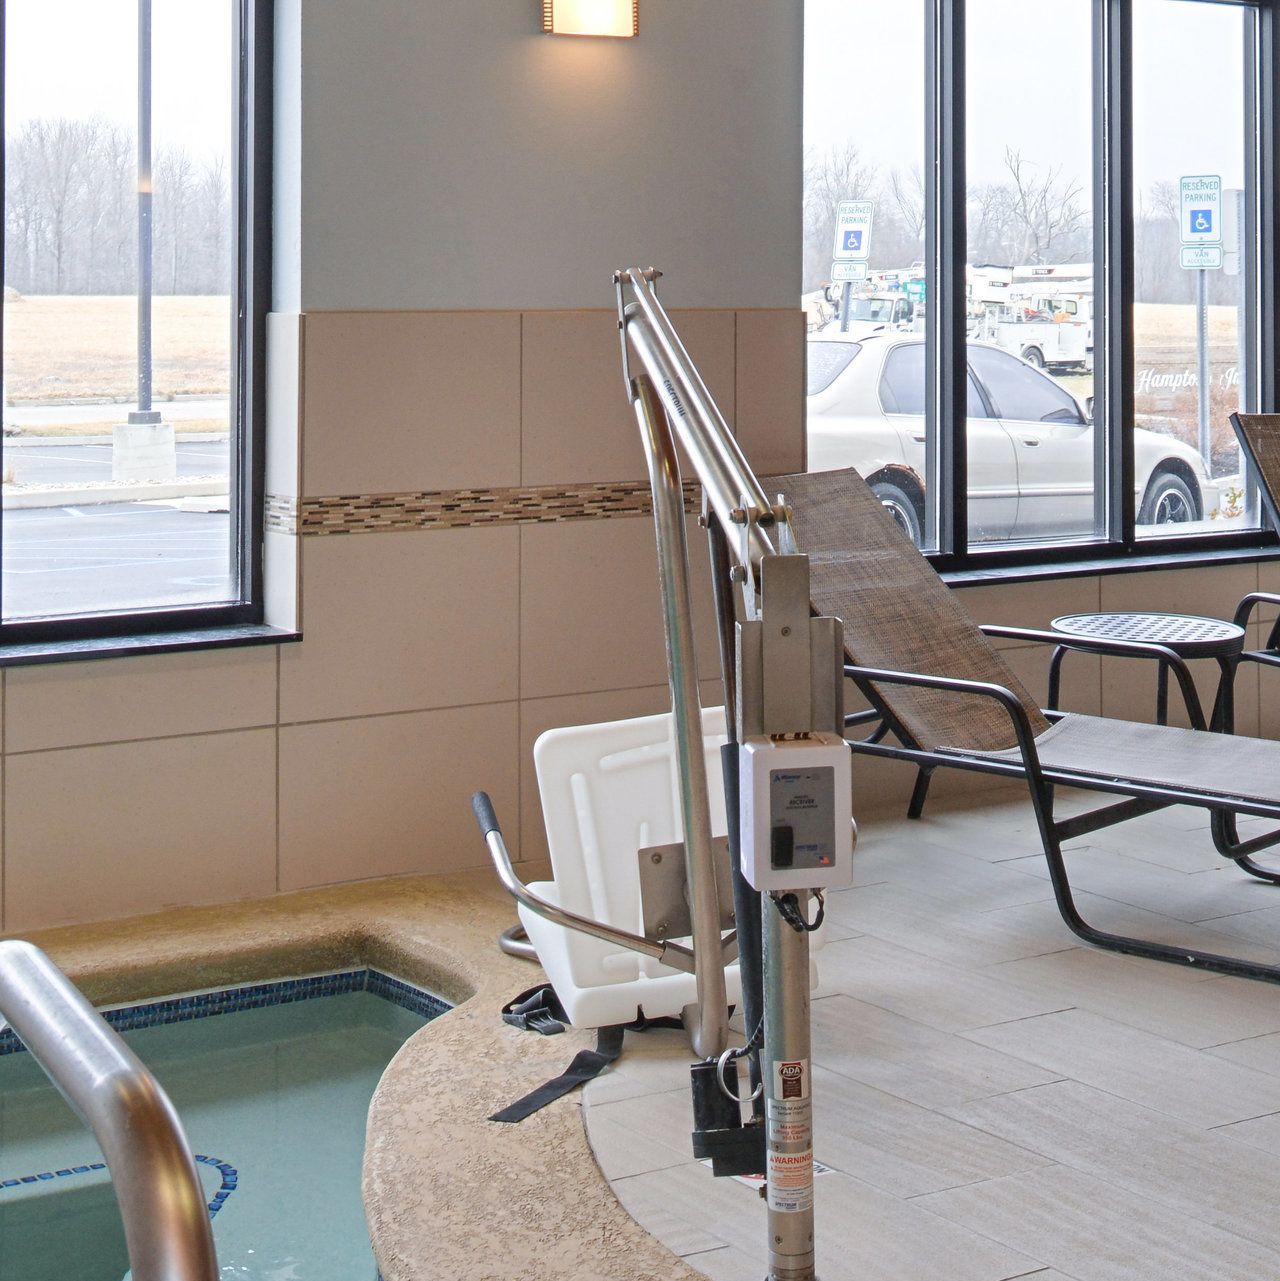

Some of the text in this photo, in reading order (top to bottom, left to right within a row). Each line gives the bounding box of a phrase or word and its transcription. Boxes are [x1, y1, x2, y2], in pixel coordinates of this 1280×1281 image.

[1182, 181, 1219, 190] RESERVED
[1184, 193, 1217, 202] PARKING
[840, 206, 871, 214] RESERVED
[841, 216, 868, 224] PARKING
[782, 1067, 801, 1075] ADA
[774, 1153, 811, 1165] WARNING
